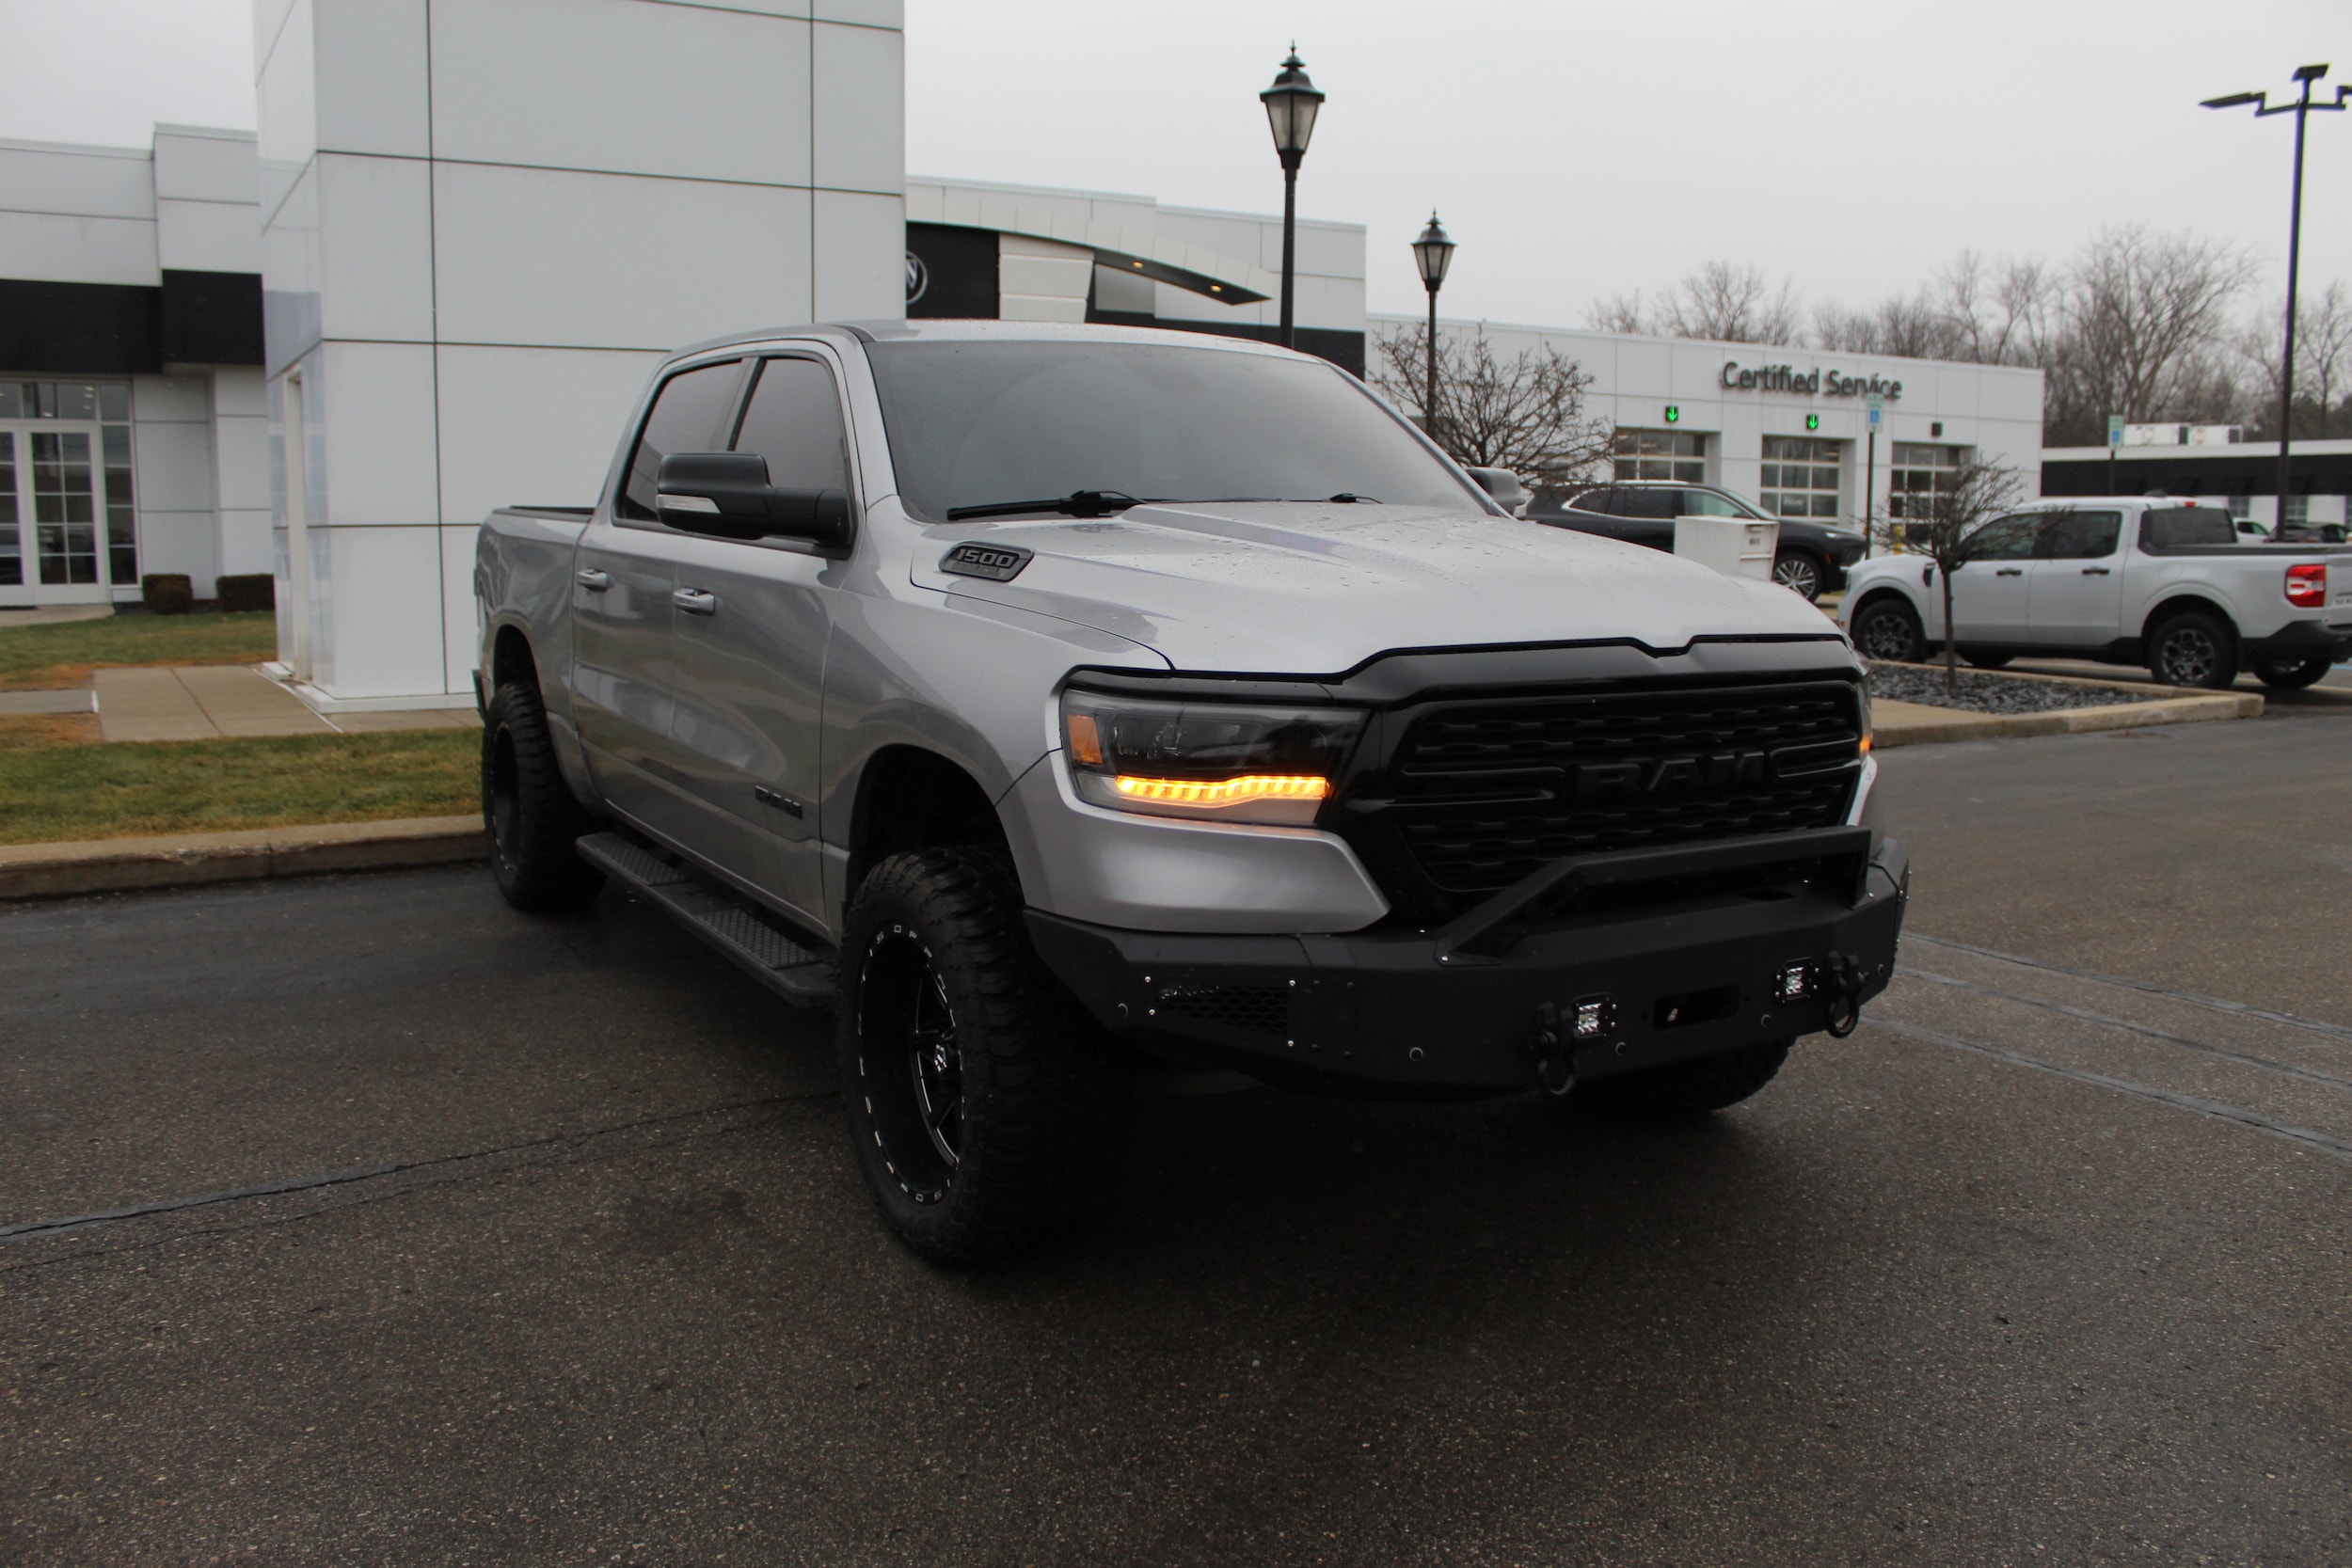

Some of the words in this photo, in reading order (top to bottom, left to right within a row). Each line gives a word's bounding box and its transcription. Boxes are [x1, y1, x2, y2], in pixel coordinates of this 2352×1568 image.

[1722, 361, 1820, 394] Certified
[1824, 370, 1902, 399] Service
[957, 548, 1016, 568] 1500
[1577, 752, 1765, 800] RAM
